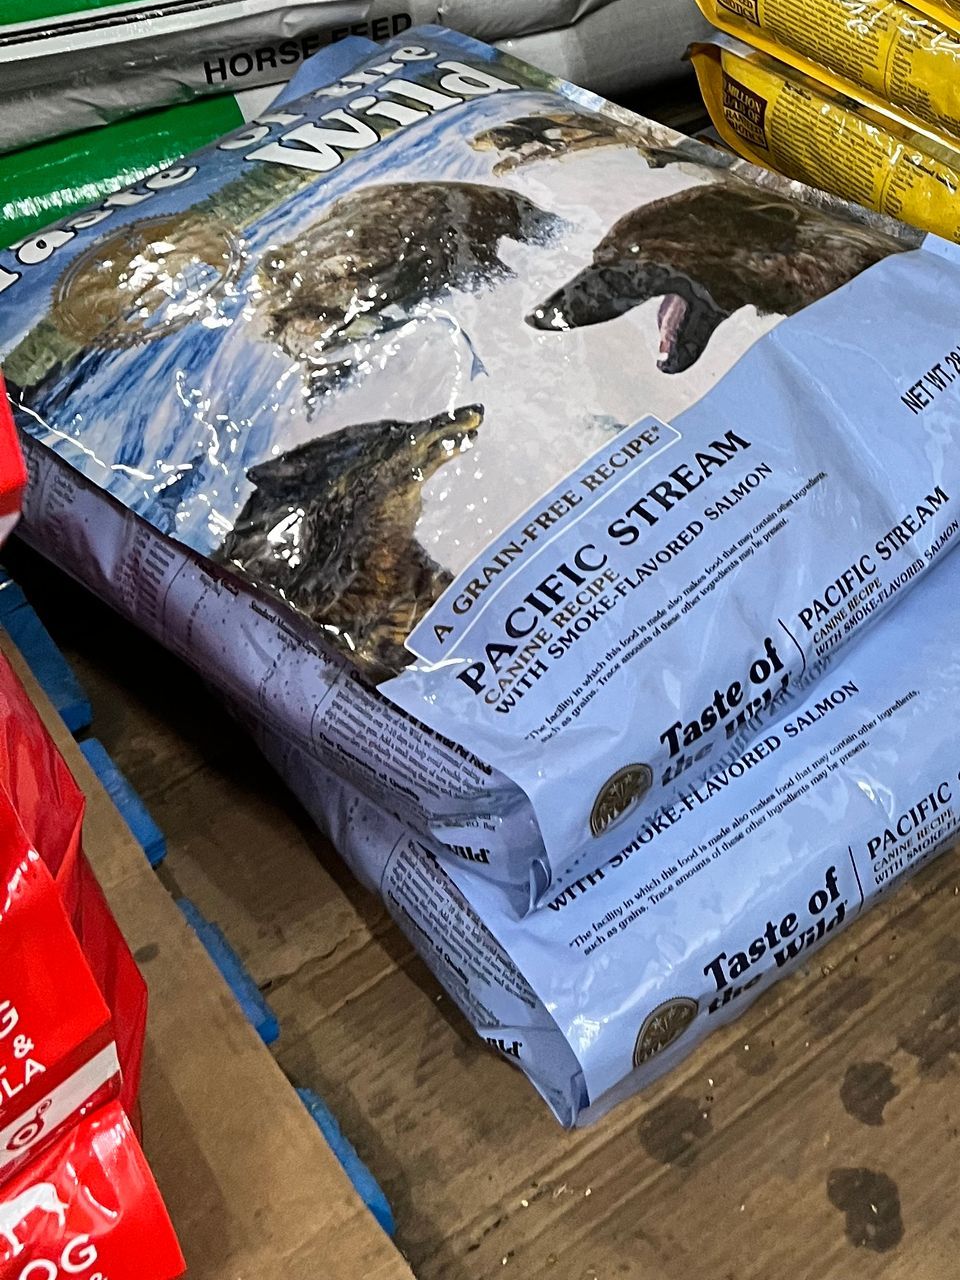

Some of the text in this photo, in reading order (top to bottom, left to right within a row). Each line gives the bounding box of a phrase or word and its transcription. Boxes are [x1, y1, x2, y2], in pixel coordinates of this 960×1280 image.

[204, 33, 320, 84] HORSE
[245, 61, 521, 173] Wild
[901, 380, 935, 415] NET
[924, 363, 956, 392] WT.
[433, 623, 454, 644] A
[452, 488, 583, 615] GRAIN-FREE
[456, 429, 752, 695] PACIFIC STREAM
[495, 462, 773, 715] WITH SMOKE-FLAVORED SALMON
[798, 485, 949, 631] PACIFIC STREAM
[813, 577, 883, 644] CANINE RECIPE
[815, 519, 959, 657] WITH SMOKE-FLAVORED SALMON
[484, 567, 620, 705] CANINE RECIPE
[660, 637, 784, 758] Taste of
[547, 680, 860, 912] WITH SMOKE-FLAVORED SALMON
[592, 906, 624, 933] facility
[623, 898, 634, 910] in
[634, 878, 661, 901] which
[660, 865, 678, 881] this
[677, 848, 698, 868] food
[699, 844, 707, 853] is
[707, 827, 731, 847] made
[731, 813, 749, 829] also
[749, 793, 776, 815] makes
[775, 778, 795, 796] food
[794, 766, 812, 782] that
[812, 753, 830, 770] may
[829, 733, 858, 756] contain
[857, 719, 877, 735] other
[866, 781, 953, 860] PACIFIC
[873, 805, 955, 873] CANINE RECIPE
[703, 865, 841, 992] Taste of
[874, 857, 905, 885] WITH
